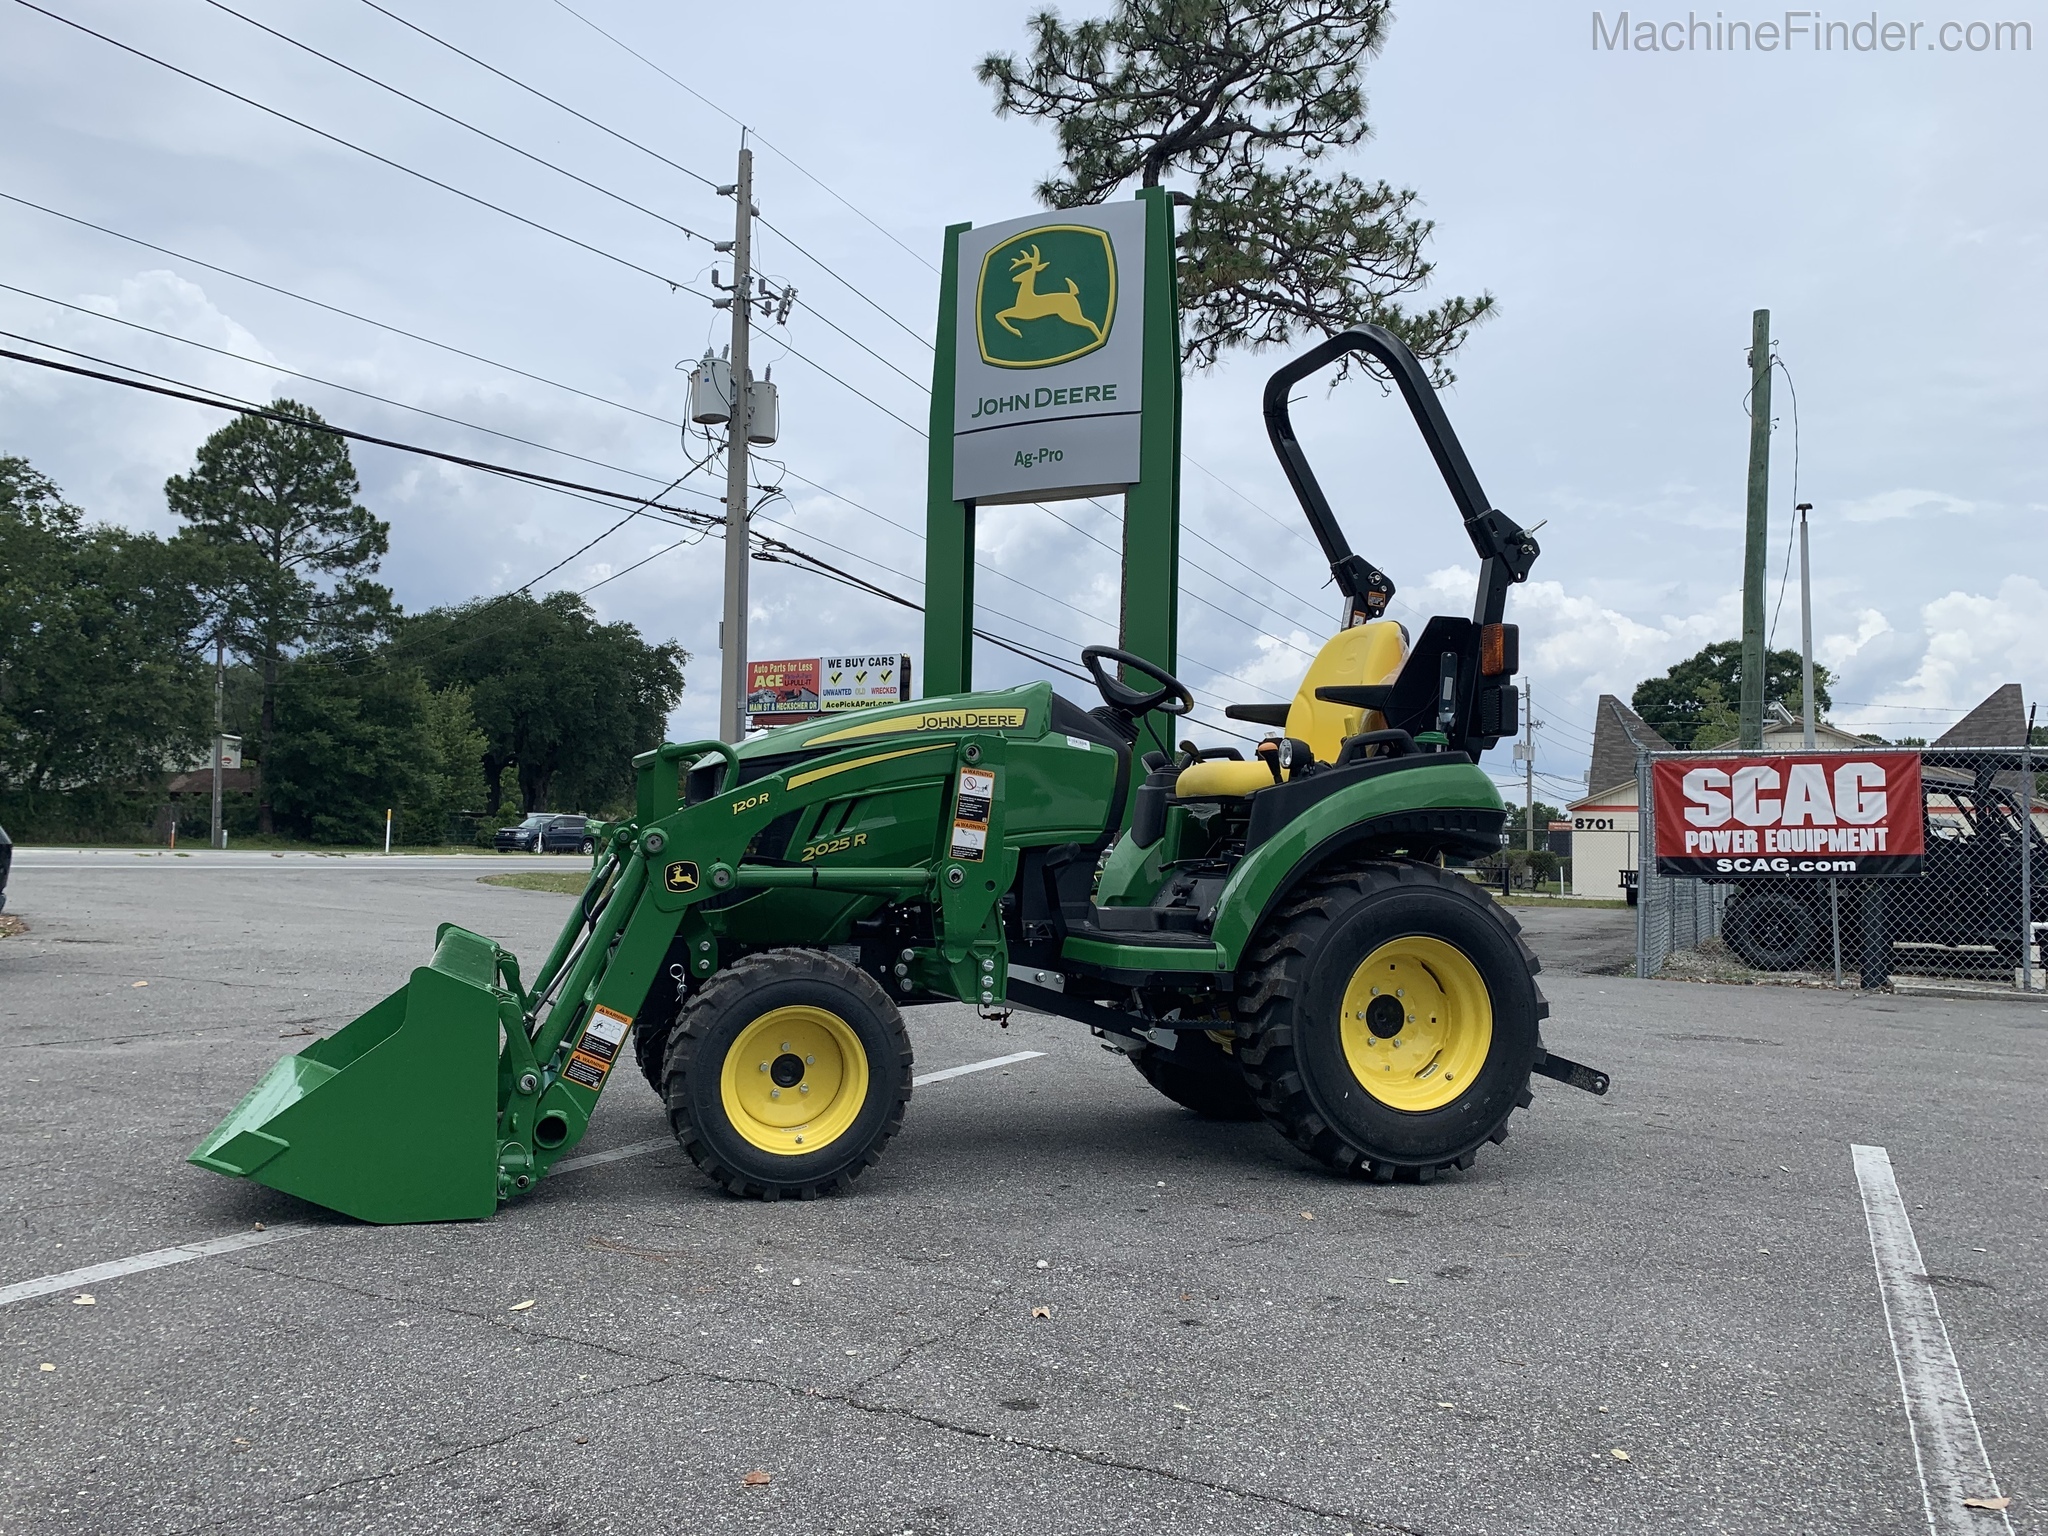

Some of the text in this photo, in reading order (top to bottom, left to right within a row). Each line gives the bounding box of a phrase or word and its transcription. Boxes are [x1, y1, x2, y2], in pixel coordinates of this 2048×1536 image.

[971, 384, 1118, 419] JOHN DEERE
[1014, 447, 1064, 468] Ag-Pro
[753, 662, 813, 674] Auto Parts for Less
[827, 656, 895, 668] WE BUY CARS
[754, 674, 784, 688] ACE
[822, 686, 898, 697] UNWANTED OLD WRECKED
[749, 703, 763, 711] MAIN
[763, 703, 770, 711] ST
[809, 701, 817, 710] DR
[917, 713, 1018, 729] JOHN DEERE
[967, 768, 993, 779] WARNING
[1682, 761, 1888, 828] SCAG
[732, 792, 770, 815] 120 R
[961, 822, 986, 831] WARNING
[1574, 818, 1614, 830] 8701
[1685, 827, 1889, 854] POWER EQUIPMENT
[801, 833, 868, 863] 2025 R
[1716, 858, 1857, 873] SCAG.com
[604, 1008, 628, 1023] WARNING
[582, 1056, 605, 1070] WARNING
